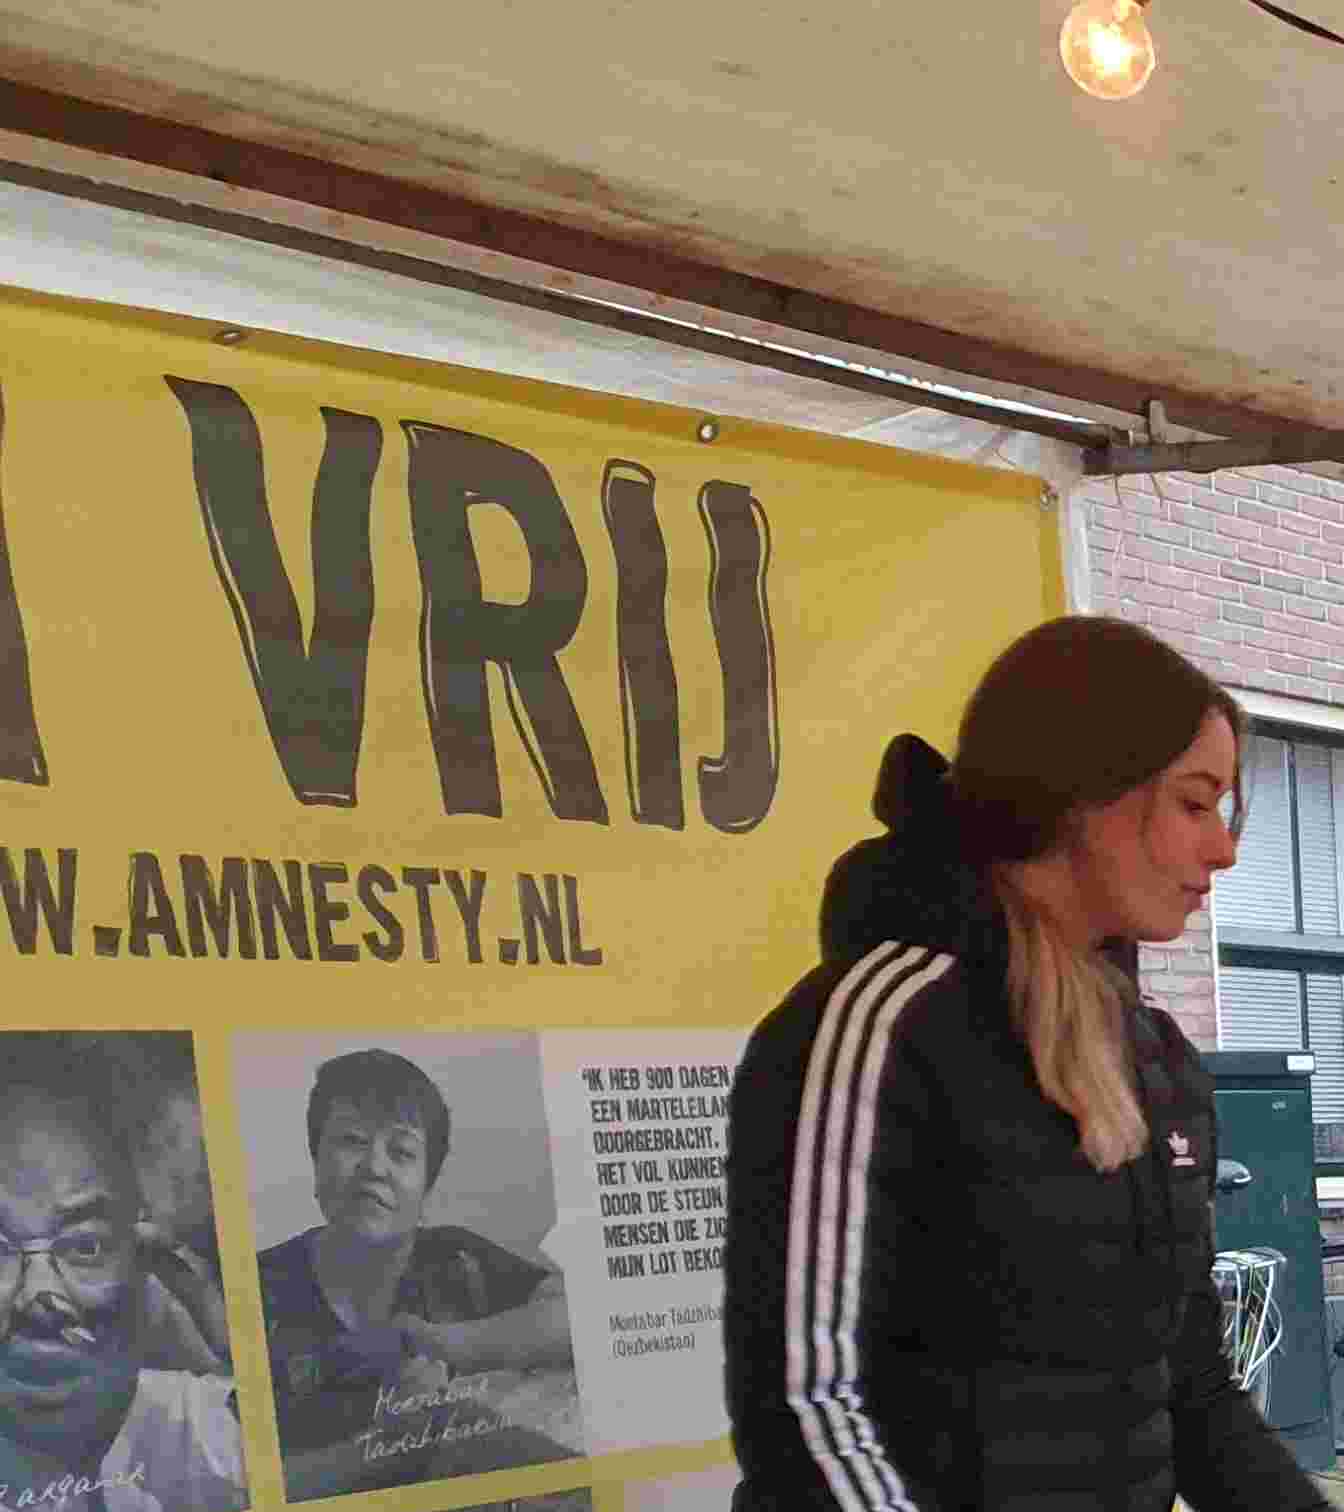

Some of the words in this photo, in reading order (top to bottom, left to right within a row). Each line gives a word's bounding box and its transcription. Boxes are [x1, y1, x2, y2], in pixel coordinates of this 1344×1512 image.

[163, 374, 780, 834] VRIJ
[608, 1067, 640, 1090] HEB
[646, 1066, 673, 1089] 900
[678, 1065, 730, 1088] DAGEN
[591, 1099, 621, 1122] EEN
[593, 1126, 720, 1154] DOORGEBRACHT.
[597, 1161, 627, 1186] HET
[632, 1160, 663, 1183] VOL
[600, 1192, 642, 1217] DOOR
[647, 1190, 670, 1213] DE
[673, 1186, 724, 1211] STEUN
[603, 1221, 669, 1248] MENSEN
[673, 1219, 700, 1242] DIE
[607, 1254, 645, 1280] MIJN
[649, 1251, 676, 1275] LOT
